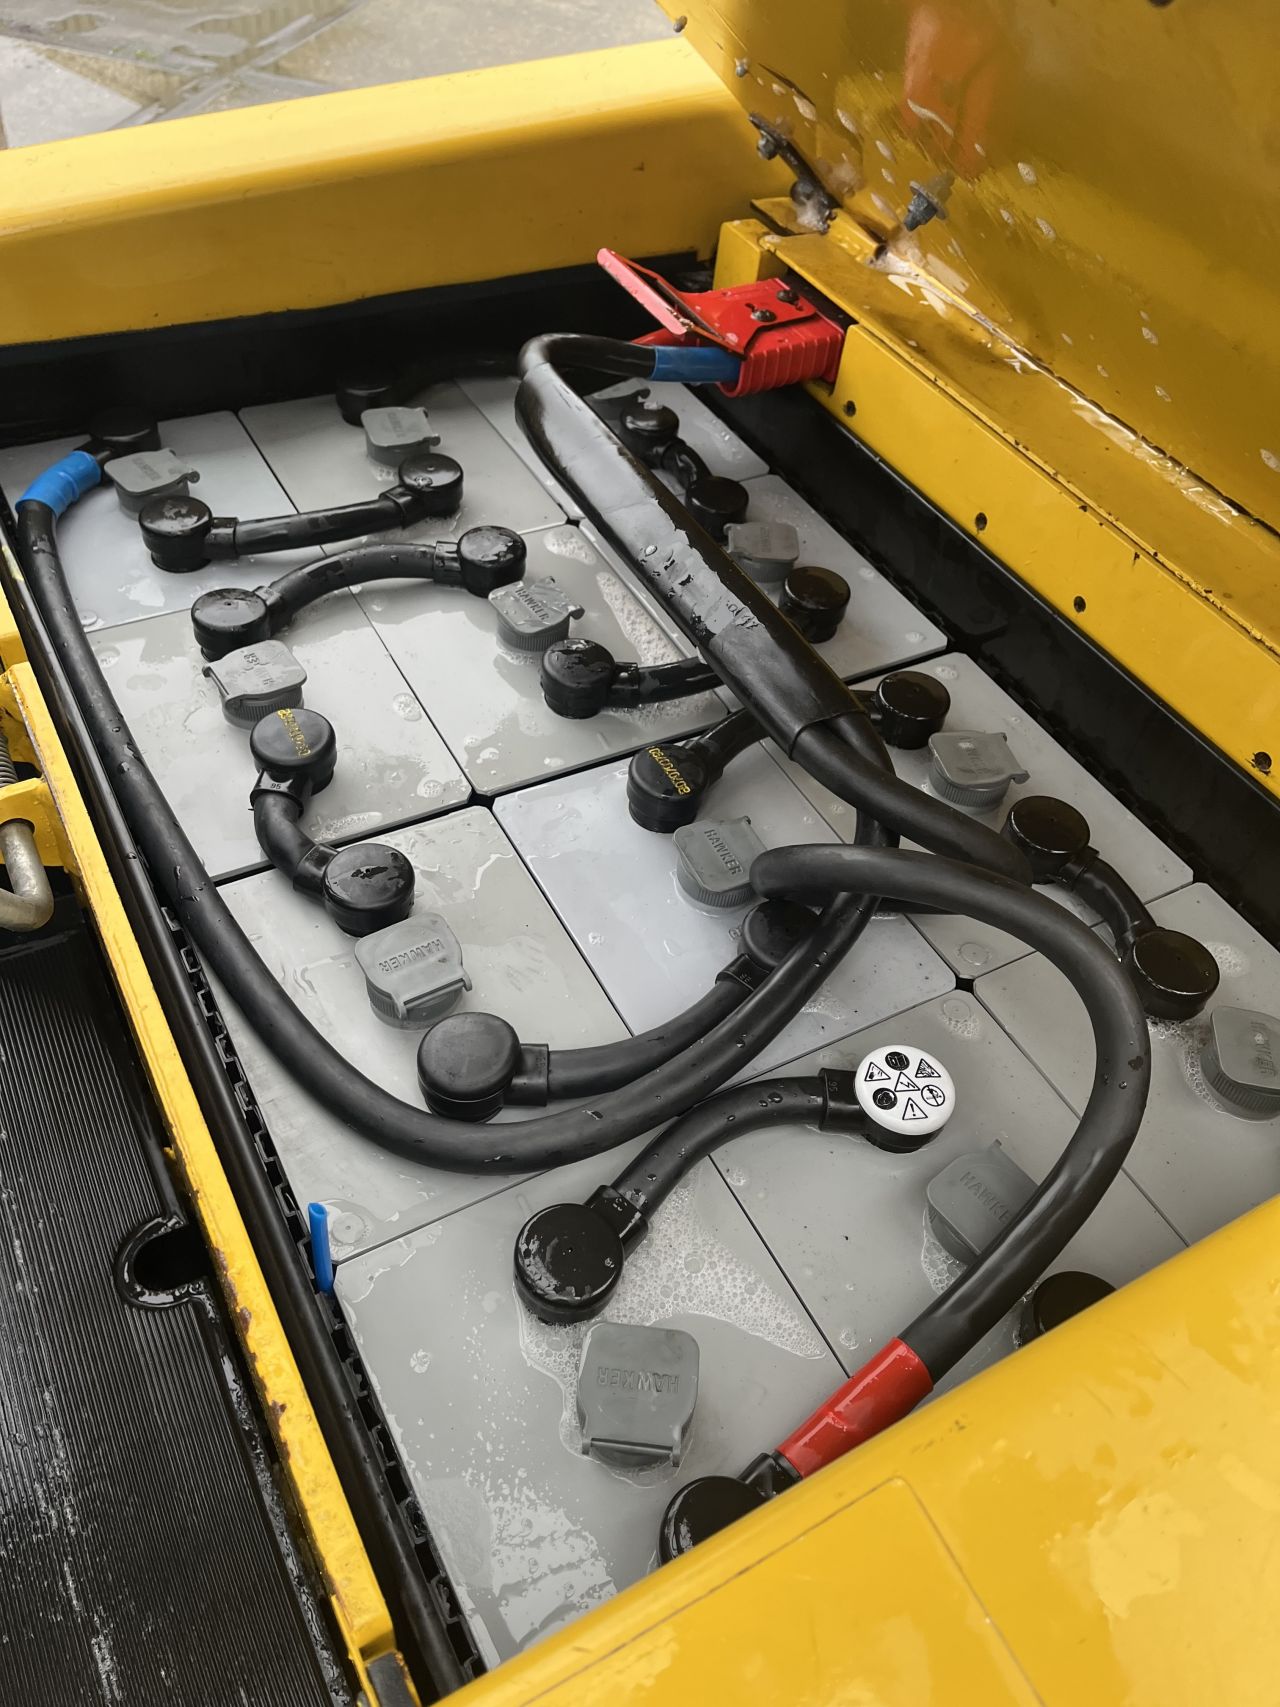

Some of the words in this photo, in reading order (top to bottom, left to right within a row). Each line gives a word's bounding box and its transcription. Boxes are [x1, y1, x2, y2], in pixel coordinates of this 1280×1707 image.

[704, 829, 743, 875] HAWKER
[379, 938, 446, 973] HAWKER
[959, 1171, 1013, 1222] HAWKE
[597, 1365, 681, 1393] HAWKER
